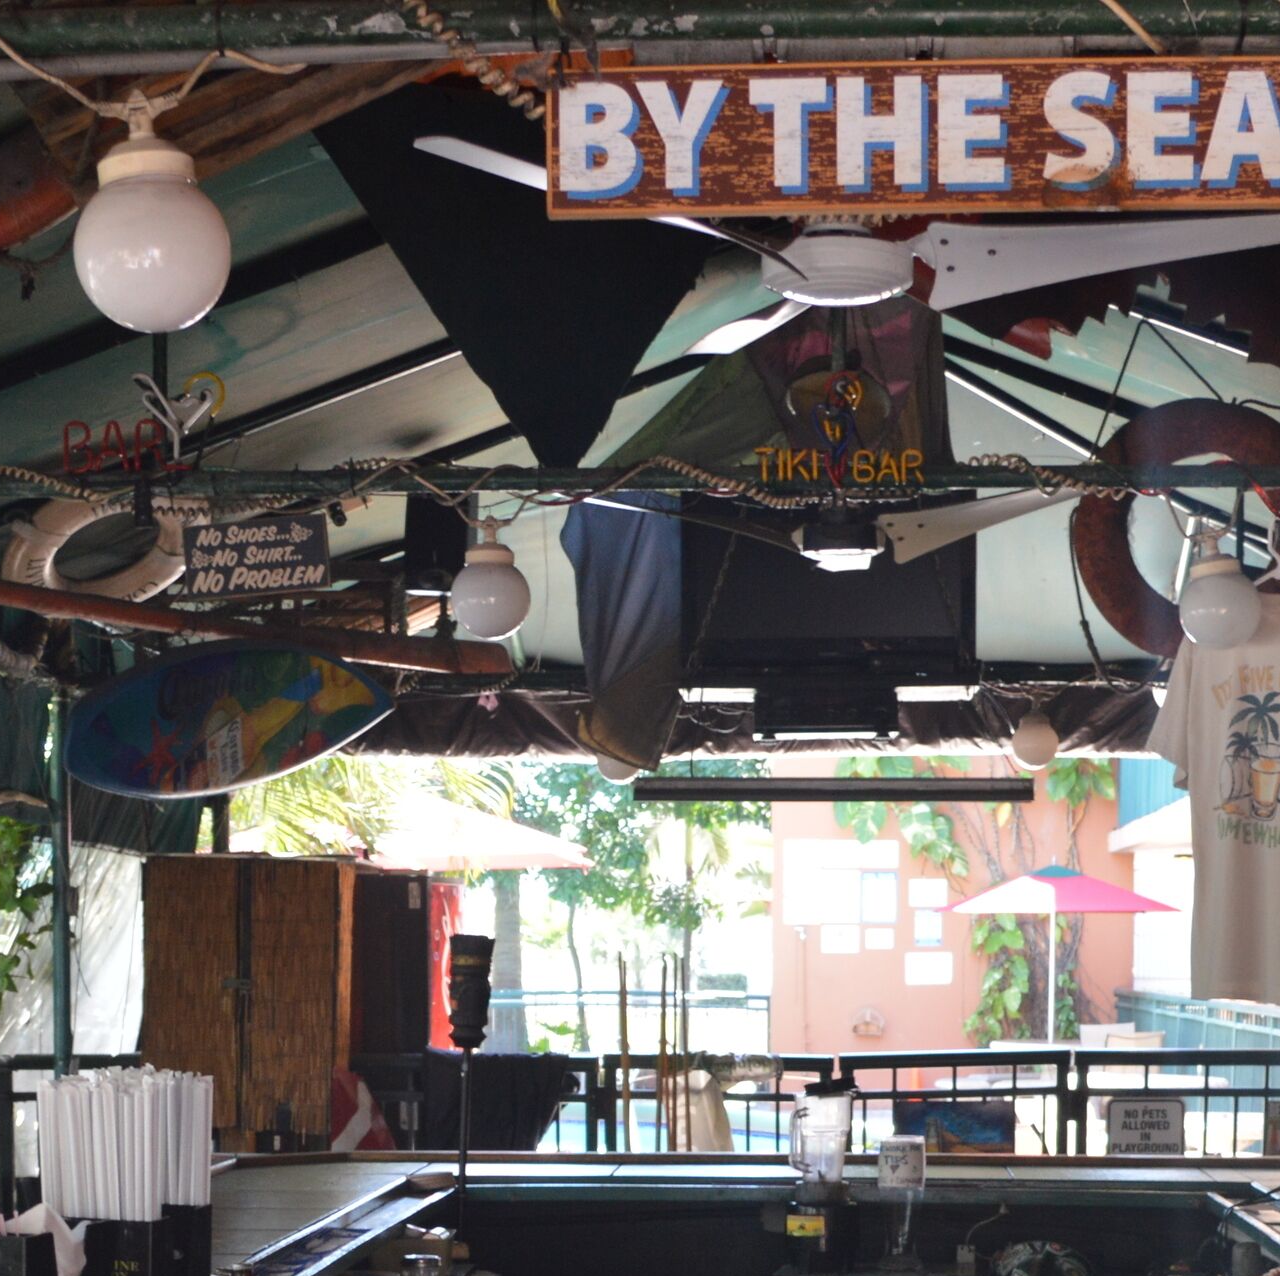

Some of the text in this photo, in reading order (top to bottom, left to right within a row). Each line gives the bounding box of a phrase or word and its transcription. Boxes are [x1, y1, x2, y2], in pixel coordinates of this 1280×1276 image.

[558, 79, 729, 199] BY
[749, 73, 1011, 195] THE
[62, 418, 192, 474] BAR
[754, 448, 925, 484] TIKI BAR
[196, 527, 220, 547] NO
[213, 548, 237, 567] NO
[192, 565, 325, 595] NO PROBLEM
[1238, 664, 1275, 696] FIVE
[1124, 1108, 1168, 1119] NO PETS
[1121, 1120, 1170, 1131] ALLOWED
[1139, 1132, 1151, 1142] IN
[1112, 1143, 1179, 1154] PLAYGROUND
